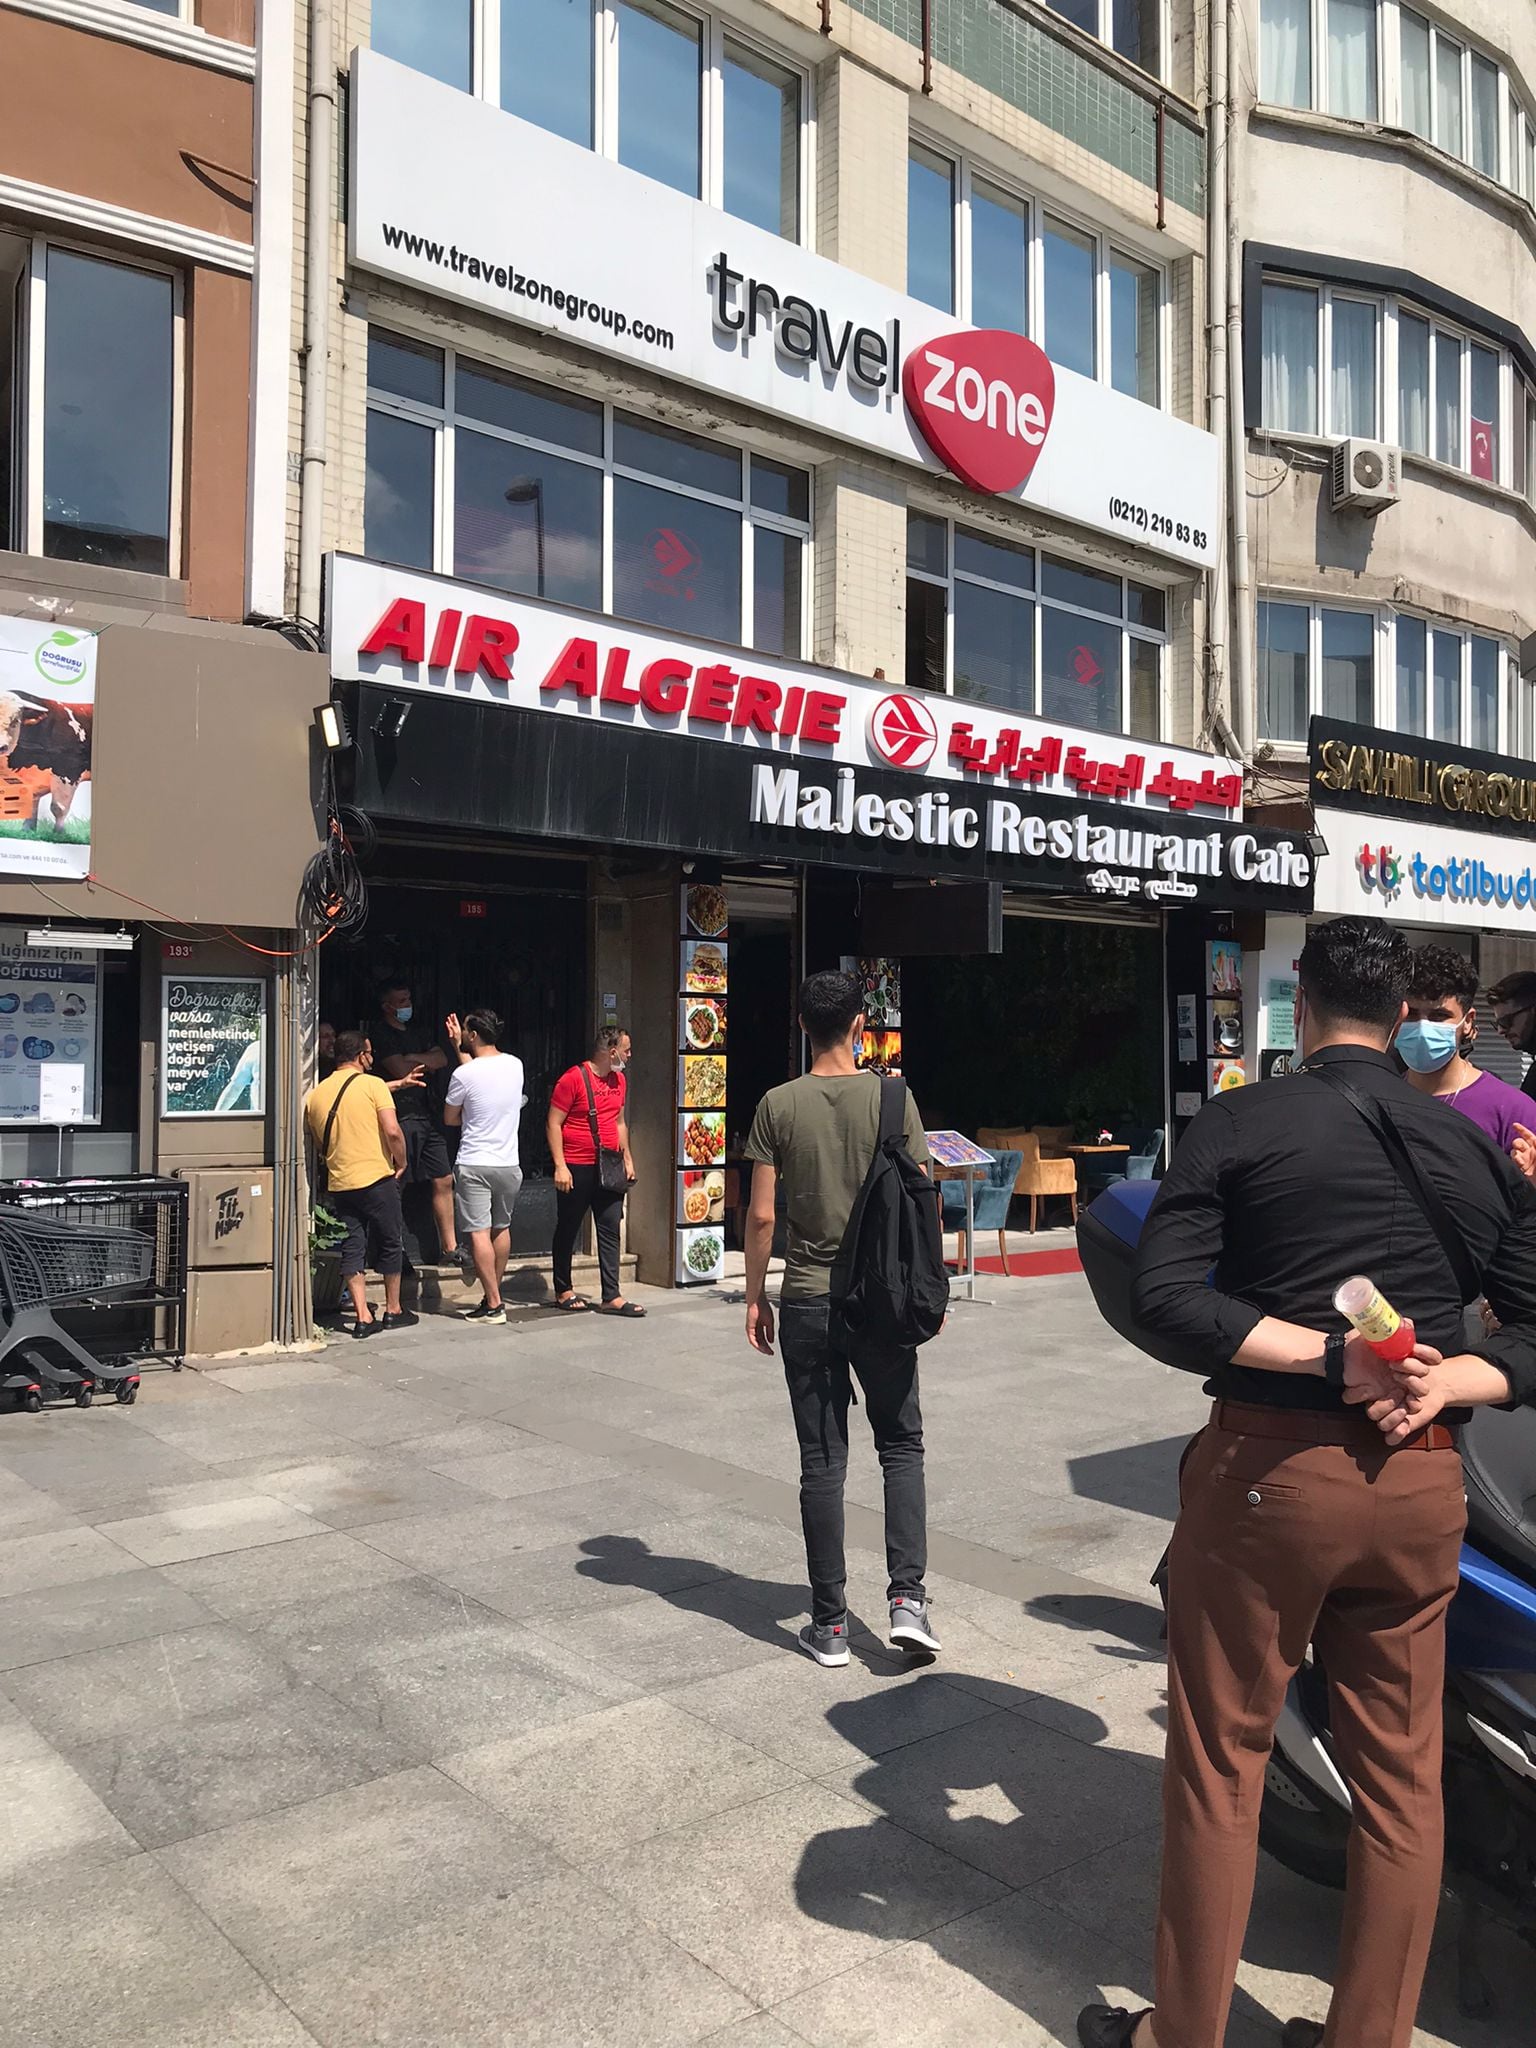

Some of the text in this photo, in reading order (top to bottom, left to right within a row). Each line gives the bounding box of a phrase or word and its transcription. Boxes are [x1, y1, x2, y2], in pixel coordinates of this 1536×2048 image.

[382, 223, 674, 350] www.travelzonegroup.com
[708, 252, 900, 396] travel
[924, 350, 1046, 446] zone
[1109, 496, 1207, 550] (0212) 219 83 83
[42, 650, 82, 668] DOĞRUSU
[358, 597, 847, 744] AIR ALGÉRIE
[749, 763, 1310, 888] Majestic Restaurant Cafe
[169, 985, 220, 1013] Doğru
[170, 1011, 213, 1023] varsa
[168, 1027, 257, 1040] memleketinde
[168, 1041, 214, 1054] yetişen
[168, 1053, 205, 1067] doğru
[168, 1068, 209, 1080] meyve
[167, 1081, 188, 1091] var
